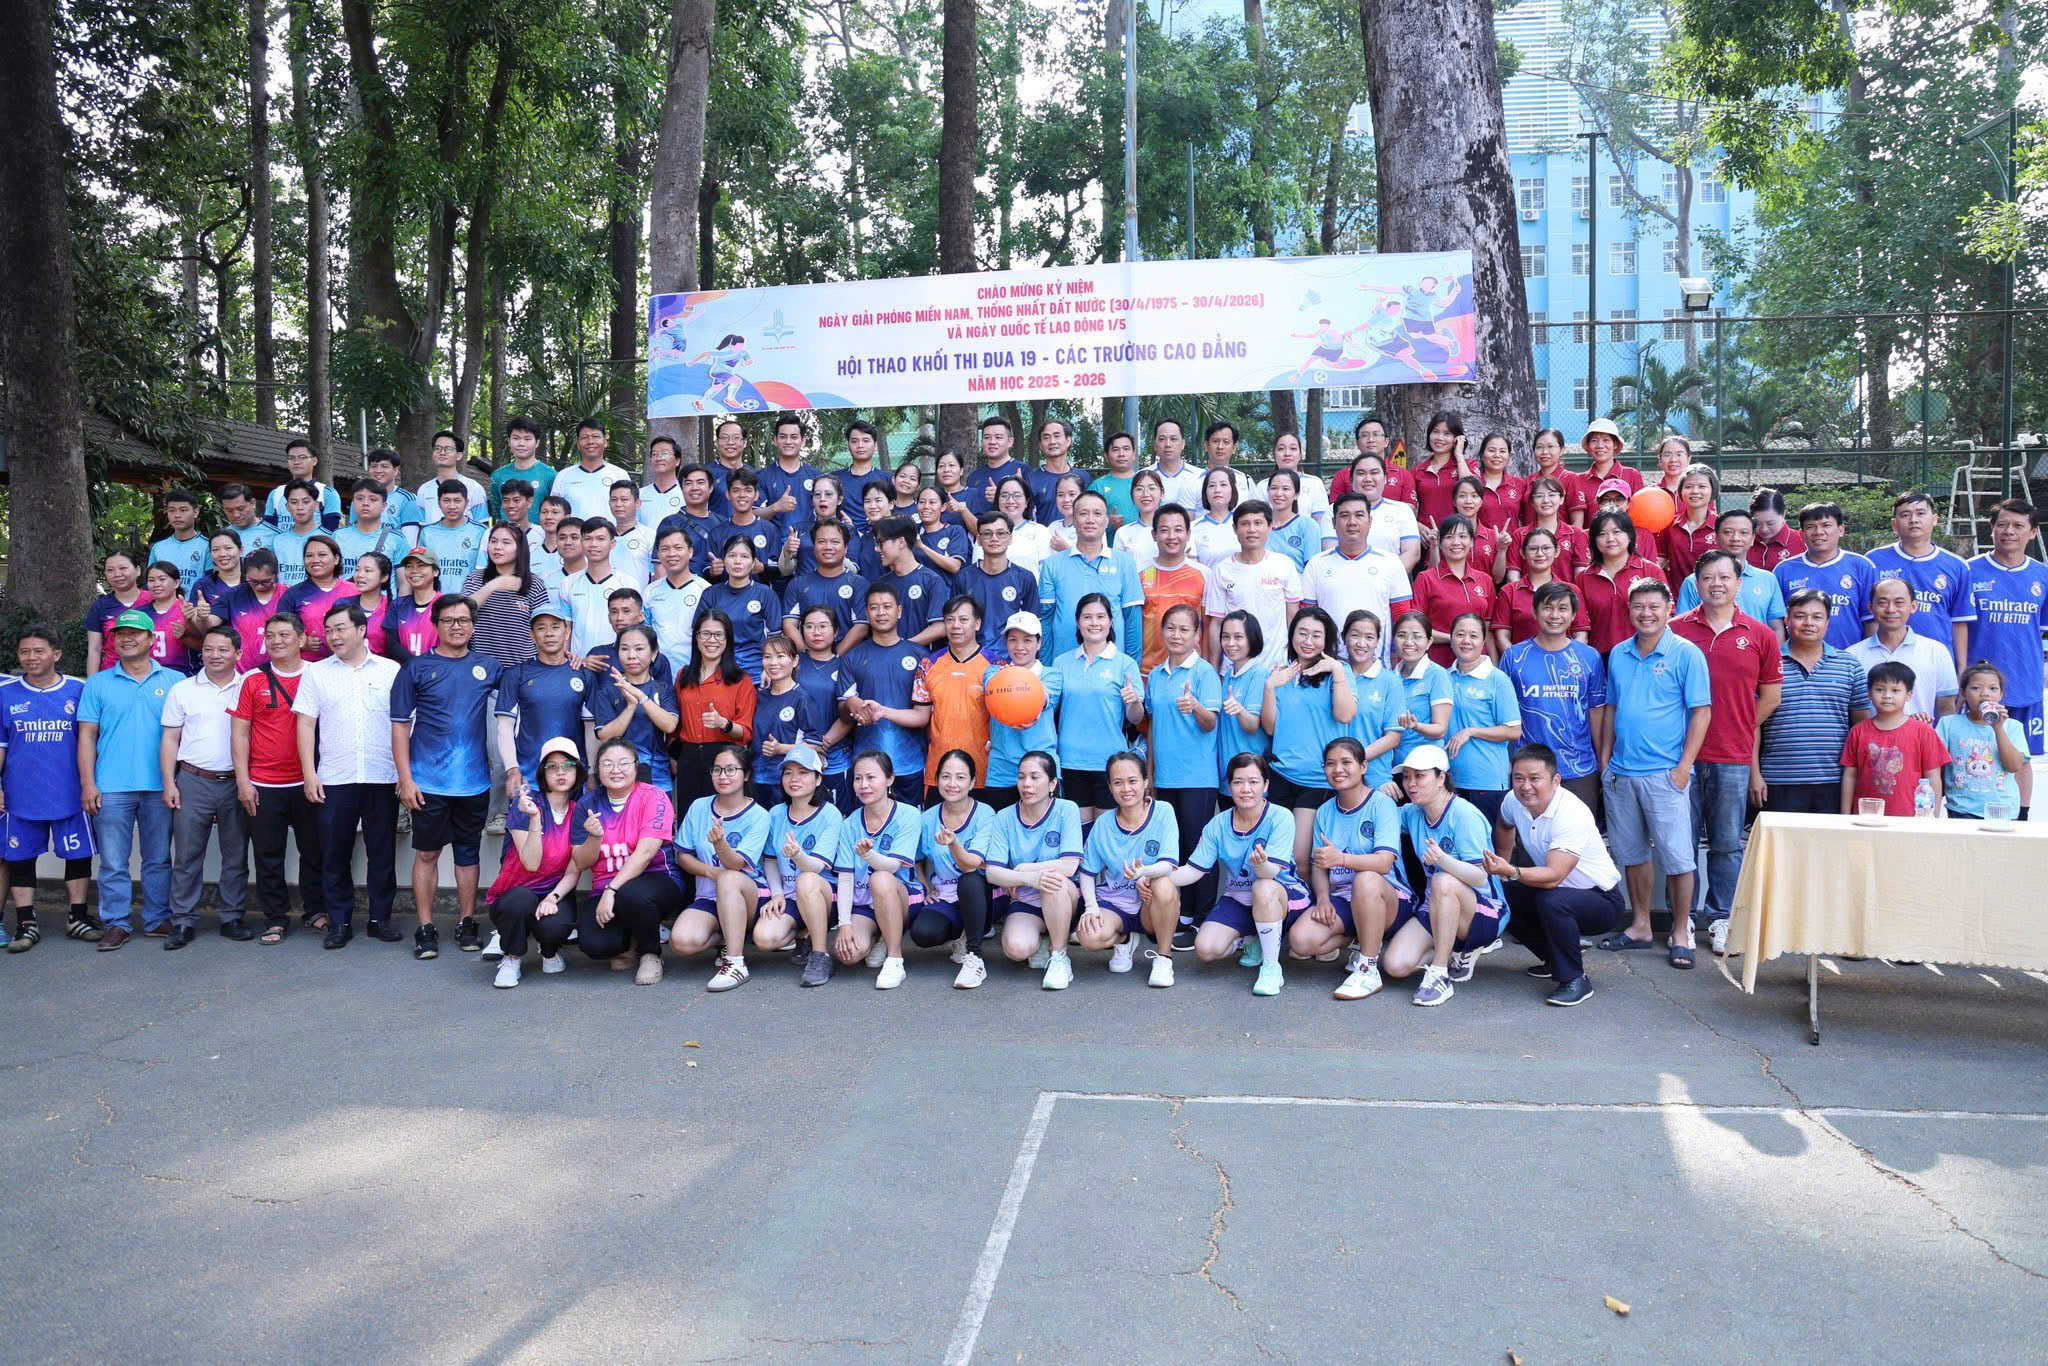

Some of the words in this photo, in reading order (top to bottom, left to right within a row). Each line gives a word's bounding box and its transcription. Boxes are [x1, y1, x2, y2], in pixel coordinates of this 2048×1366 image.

[977, 284, 1007, 300] CHÀO
[1010, 281, 1043, 298] MỪNG
[1066, 278, 1094, 297] NIỆM
[819, 312, 848, 328] NGÀY
[852, 309, 873, 326] GIẢI
[876, 308, 912, 325] PHÓNG
[915, 304, 941, 323] MIỀN
[944, 307, 973, 321] NAM,
[977, 300, 1013, 319] THỐNG
[1016, 298, 1046, 317] NHẤT
[1050, 296, 1072, 315] ĐẤT
[1075, 296, 1106, 313] NƯỚC
[947, 323, 962, 340] VÀ
[966, 322, 997, 339] NGÀY
[1001, 318, 1031, 337] QUỐC
[1034, 316, 1047, 335] TẾ
[1049, 320, 1071, 334] LAO
[1074, 316, 1105, 334] ĐỘNG
[1108, 318, 1127, 331] 1/5
[837, 355, 862, 379] HỘI
[867, 356, 907, 375] THAO
[912, 347, 948, 373] KHỐI
[953, 353, 978, 370] THI
[983, 350, 1015, 369] ĐUA
[1020, 350, 1037, 367] 19
[1055, 343, 1087, 365] CÁC
[1093, 340, 1158, 363] TRƯỜNG
[1163, 342, 1197, 360] CAO
[1202, 332, 1248, 359] ĐẲNG
[968, 374, 996, 392] NĂM
[1000, 375, 1025, 392] HỌC
[1028, 374, 1060, 389] 2025
[1073, 372, 1107, 387] 2026
[279, 563, 305, 573] Emira
[438, 557, 469, 568] irates
[2003, 612, 2031, 625] BETTER
[1542, 684, 1579, 692] INFINITE
[1542, 691, 1579, 699] ATHLETE
[14, 718, 73, 732] Emirates
[2028, 717, 2044, 737] 12
[25, 731, 36, 743] FLY
[37, 731, 64, 742] BETTER
[63, 833, 81, 852] 15
